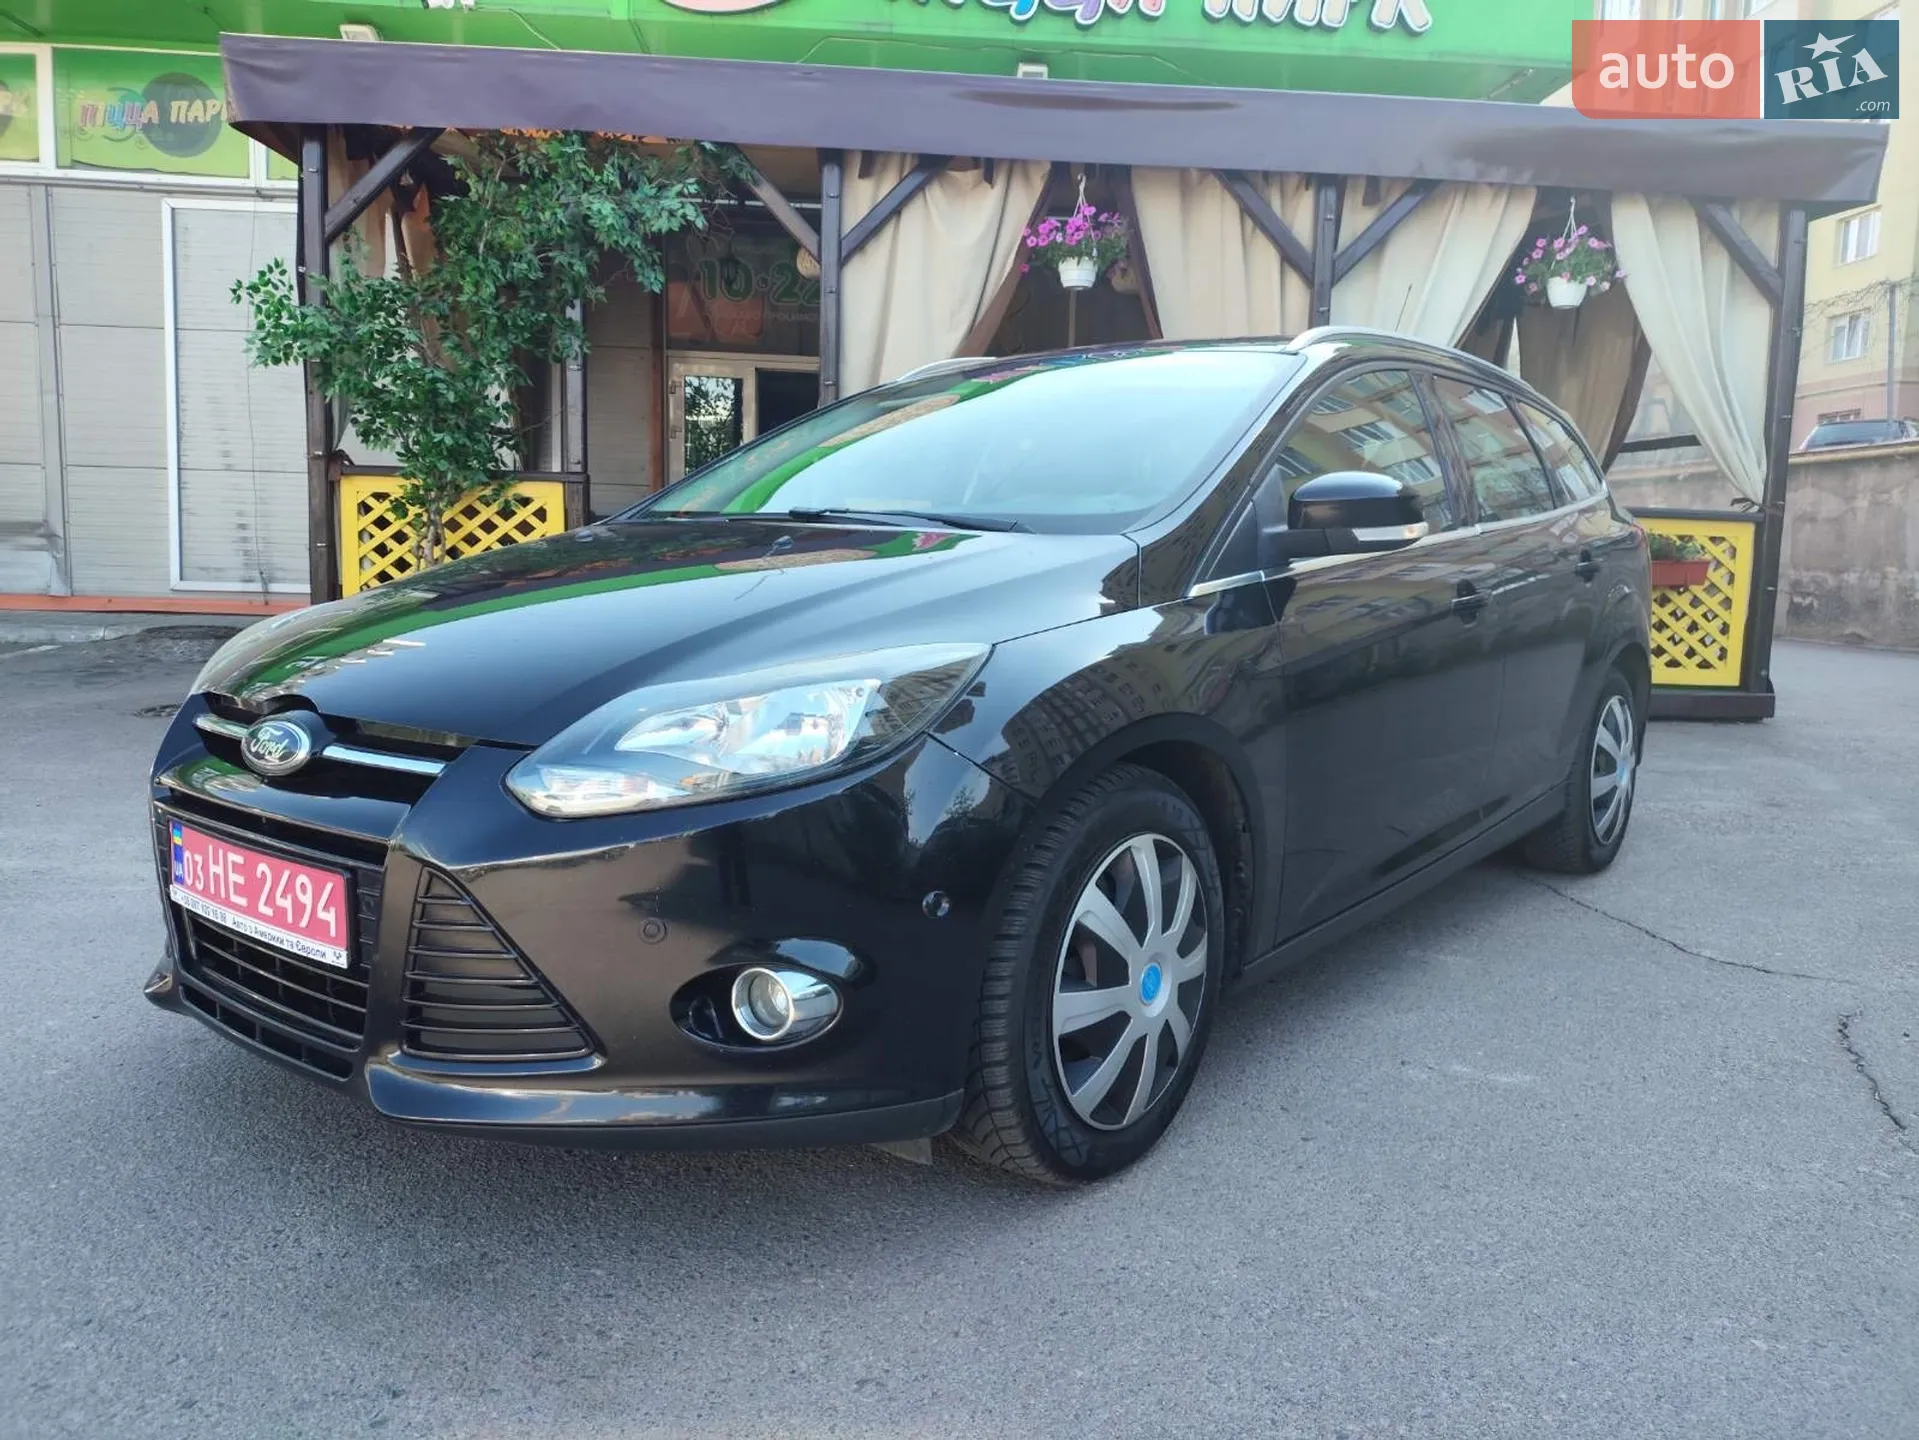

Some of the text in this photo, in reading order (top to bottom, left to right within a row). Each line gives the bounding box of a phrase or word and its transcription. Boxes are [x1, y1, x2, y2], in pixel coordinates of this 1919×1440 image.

[249, 726, 289, 759] Ford
[184, 849, 205, 892] 03
[256, 862, 336, 938] 2494
